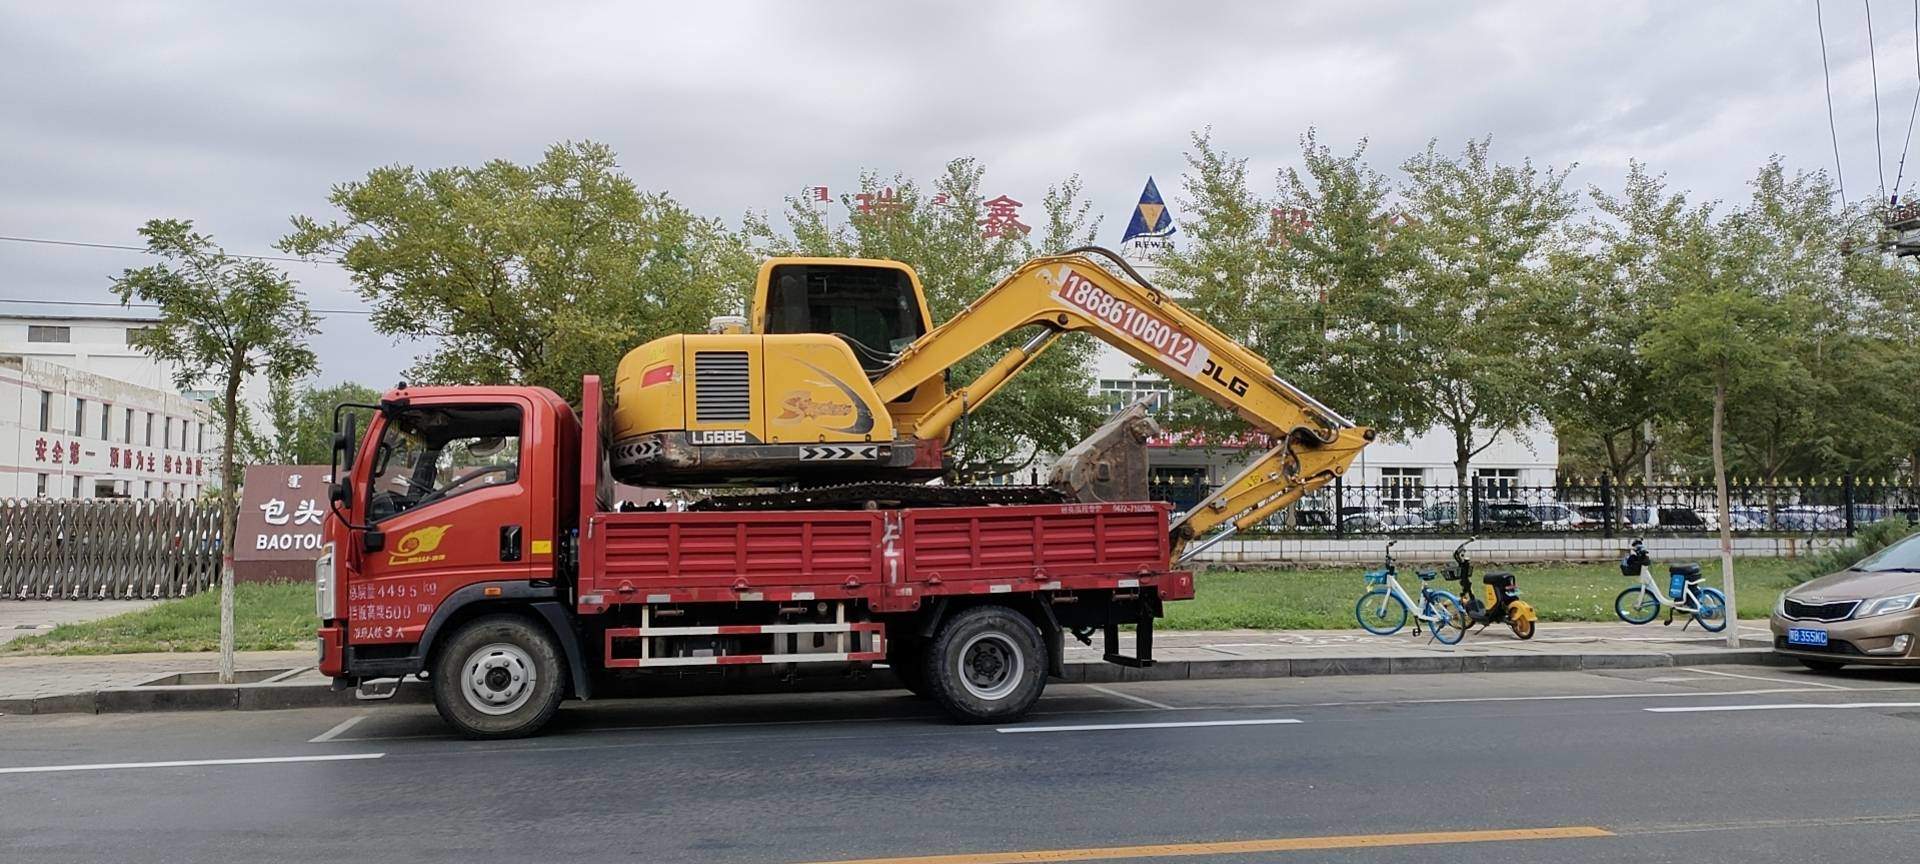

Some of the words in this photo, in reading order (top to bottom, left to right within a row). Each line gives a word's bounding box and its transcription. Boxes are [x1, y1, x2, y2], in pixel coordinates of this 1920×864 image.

[1064, 274, 1195, 366] 18686106012
[34, 436, 96, 465] 安全第一
[109, 446, 156, 473] 预防为主
[692, 430, 746, 444] LG685
